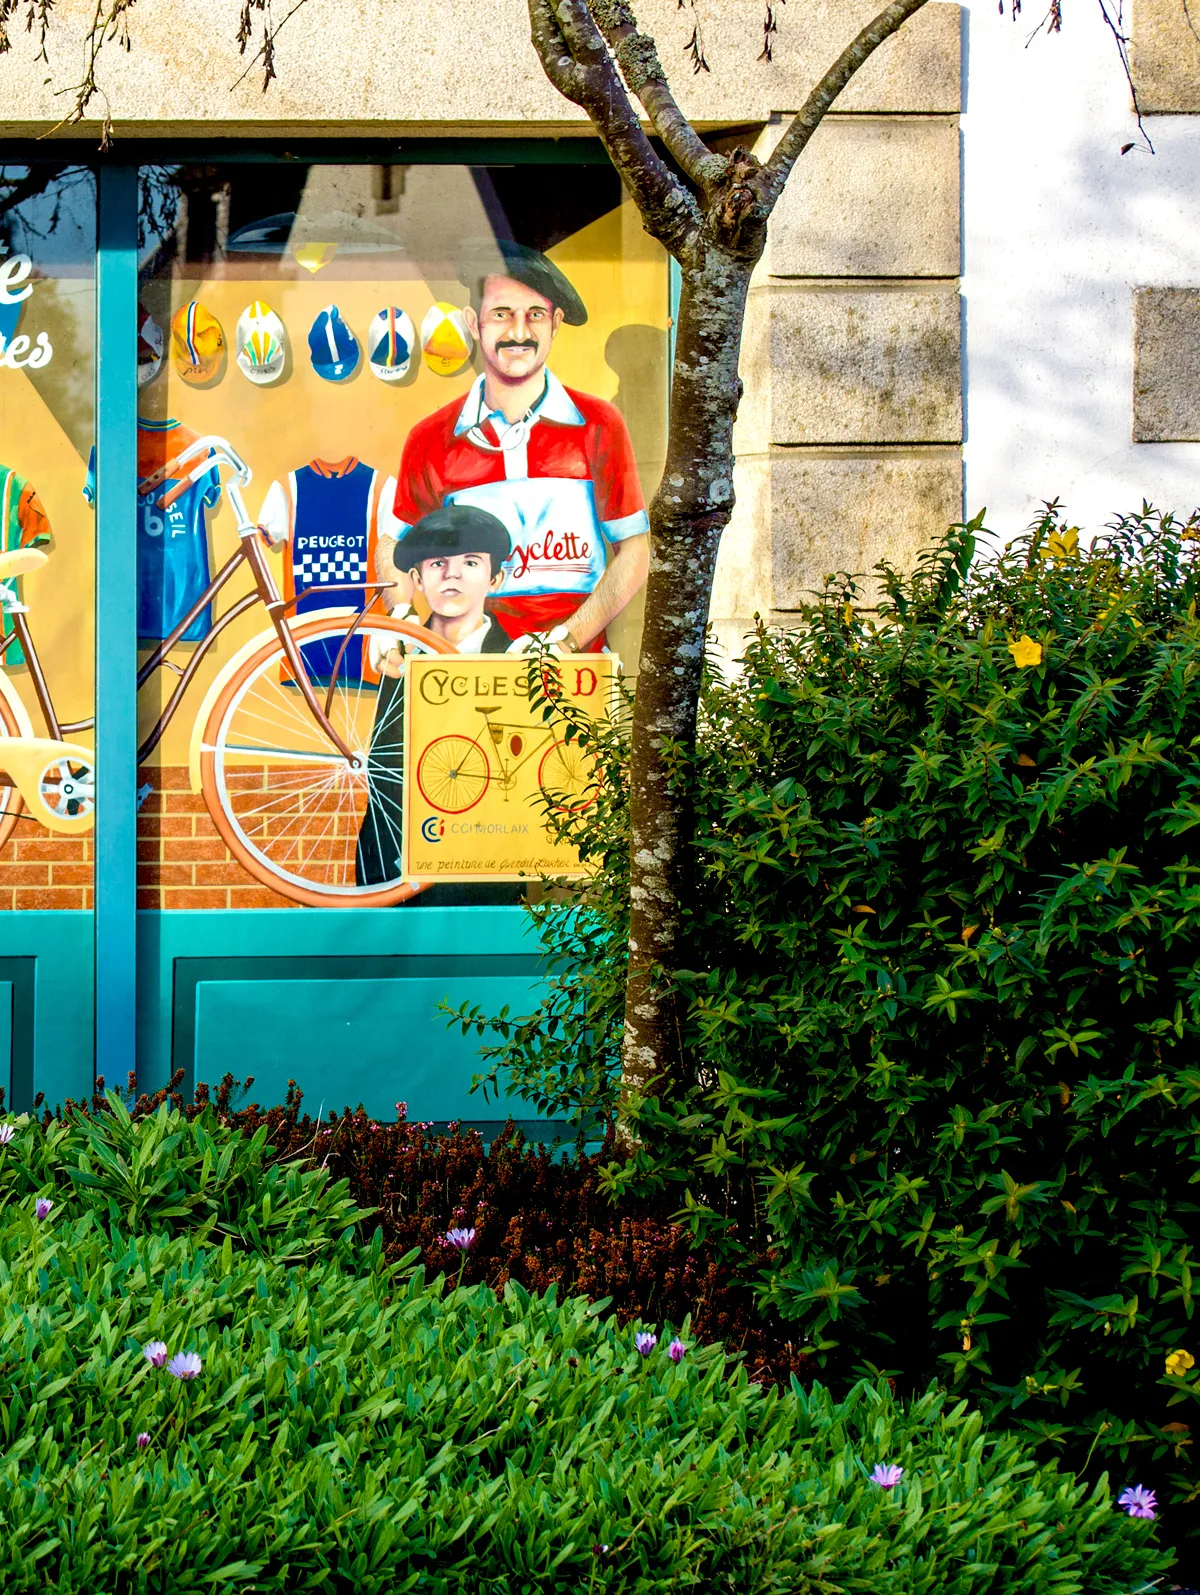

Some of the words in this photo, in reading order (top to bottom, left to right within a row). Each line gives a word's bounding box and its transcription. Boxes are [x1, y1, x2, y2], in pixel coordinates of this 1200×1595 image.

[297, 535, 364, 549] PEUGEOT
[506, 529, 592, 578] yclette
[419, 668, 530, 705] CYCLES
[475, 823, 529, 834] MORLAIX
[485, 859, 496, 869] de
